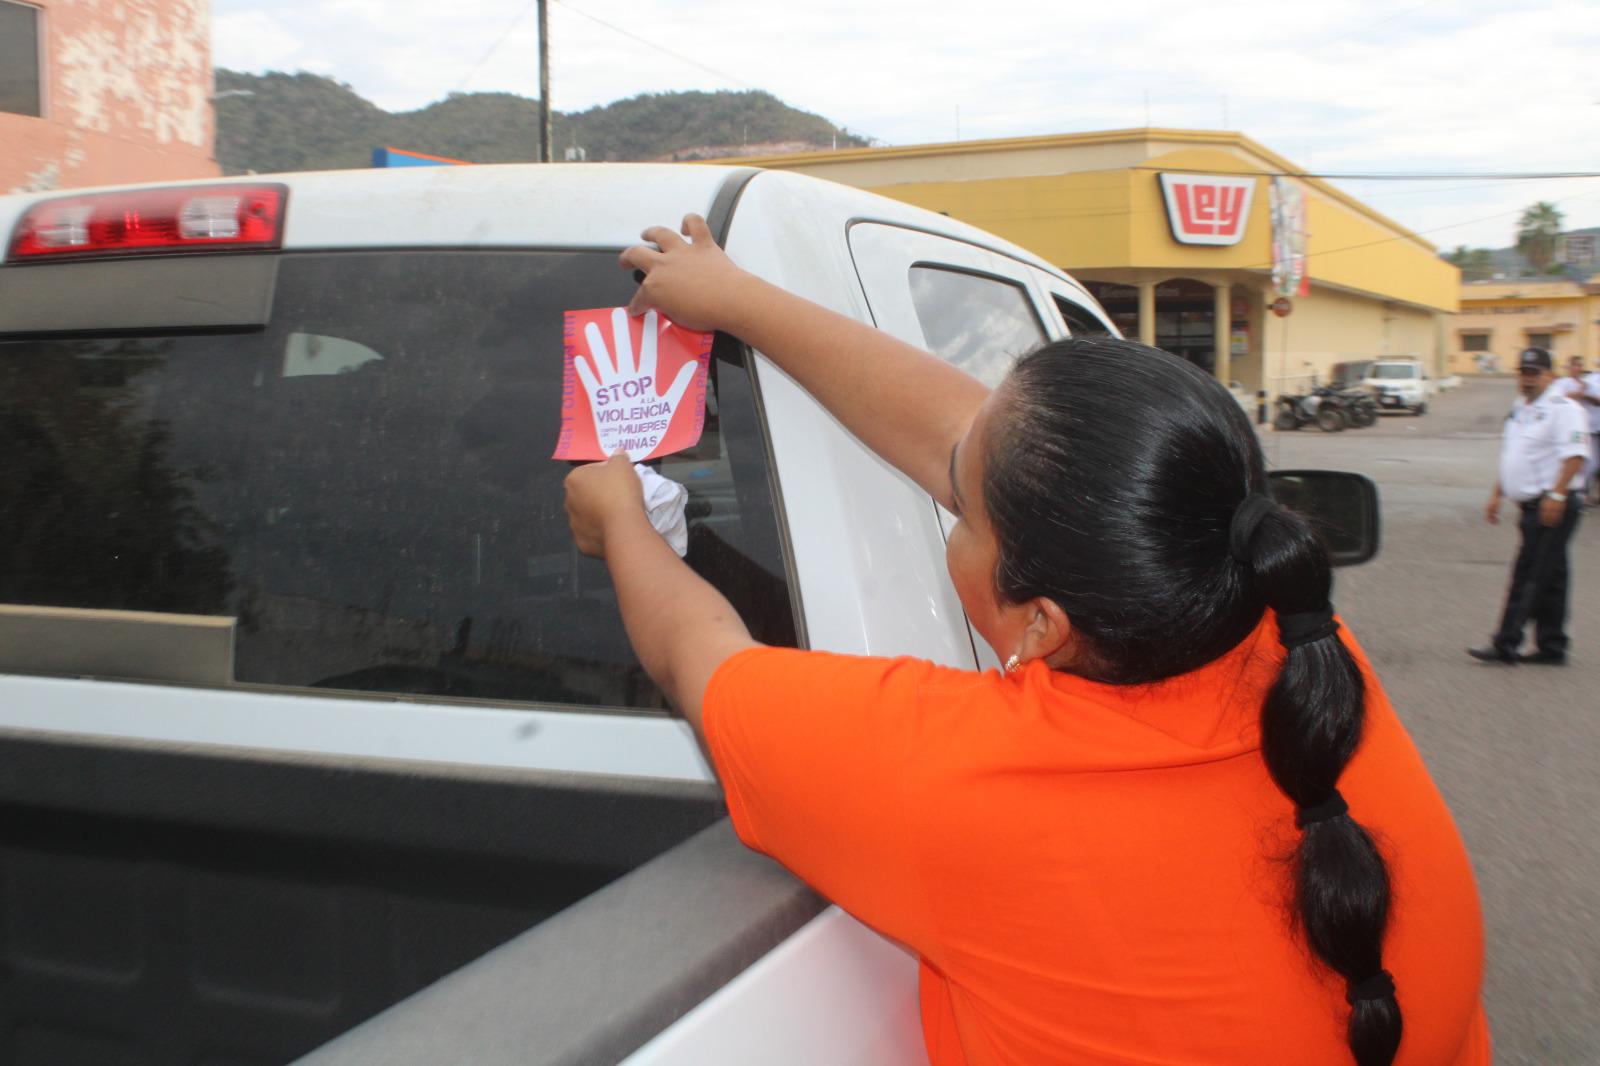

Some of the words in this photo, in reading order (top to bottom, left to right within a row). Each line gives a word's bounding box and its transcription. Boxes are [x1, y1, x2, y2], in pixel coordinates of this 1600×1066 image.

[596, 375, 652, 406] STOP
[597, 402, 671, 423] VIOLENCIA
[618, 419, 667, 434] MUJERES
